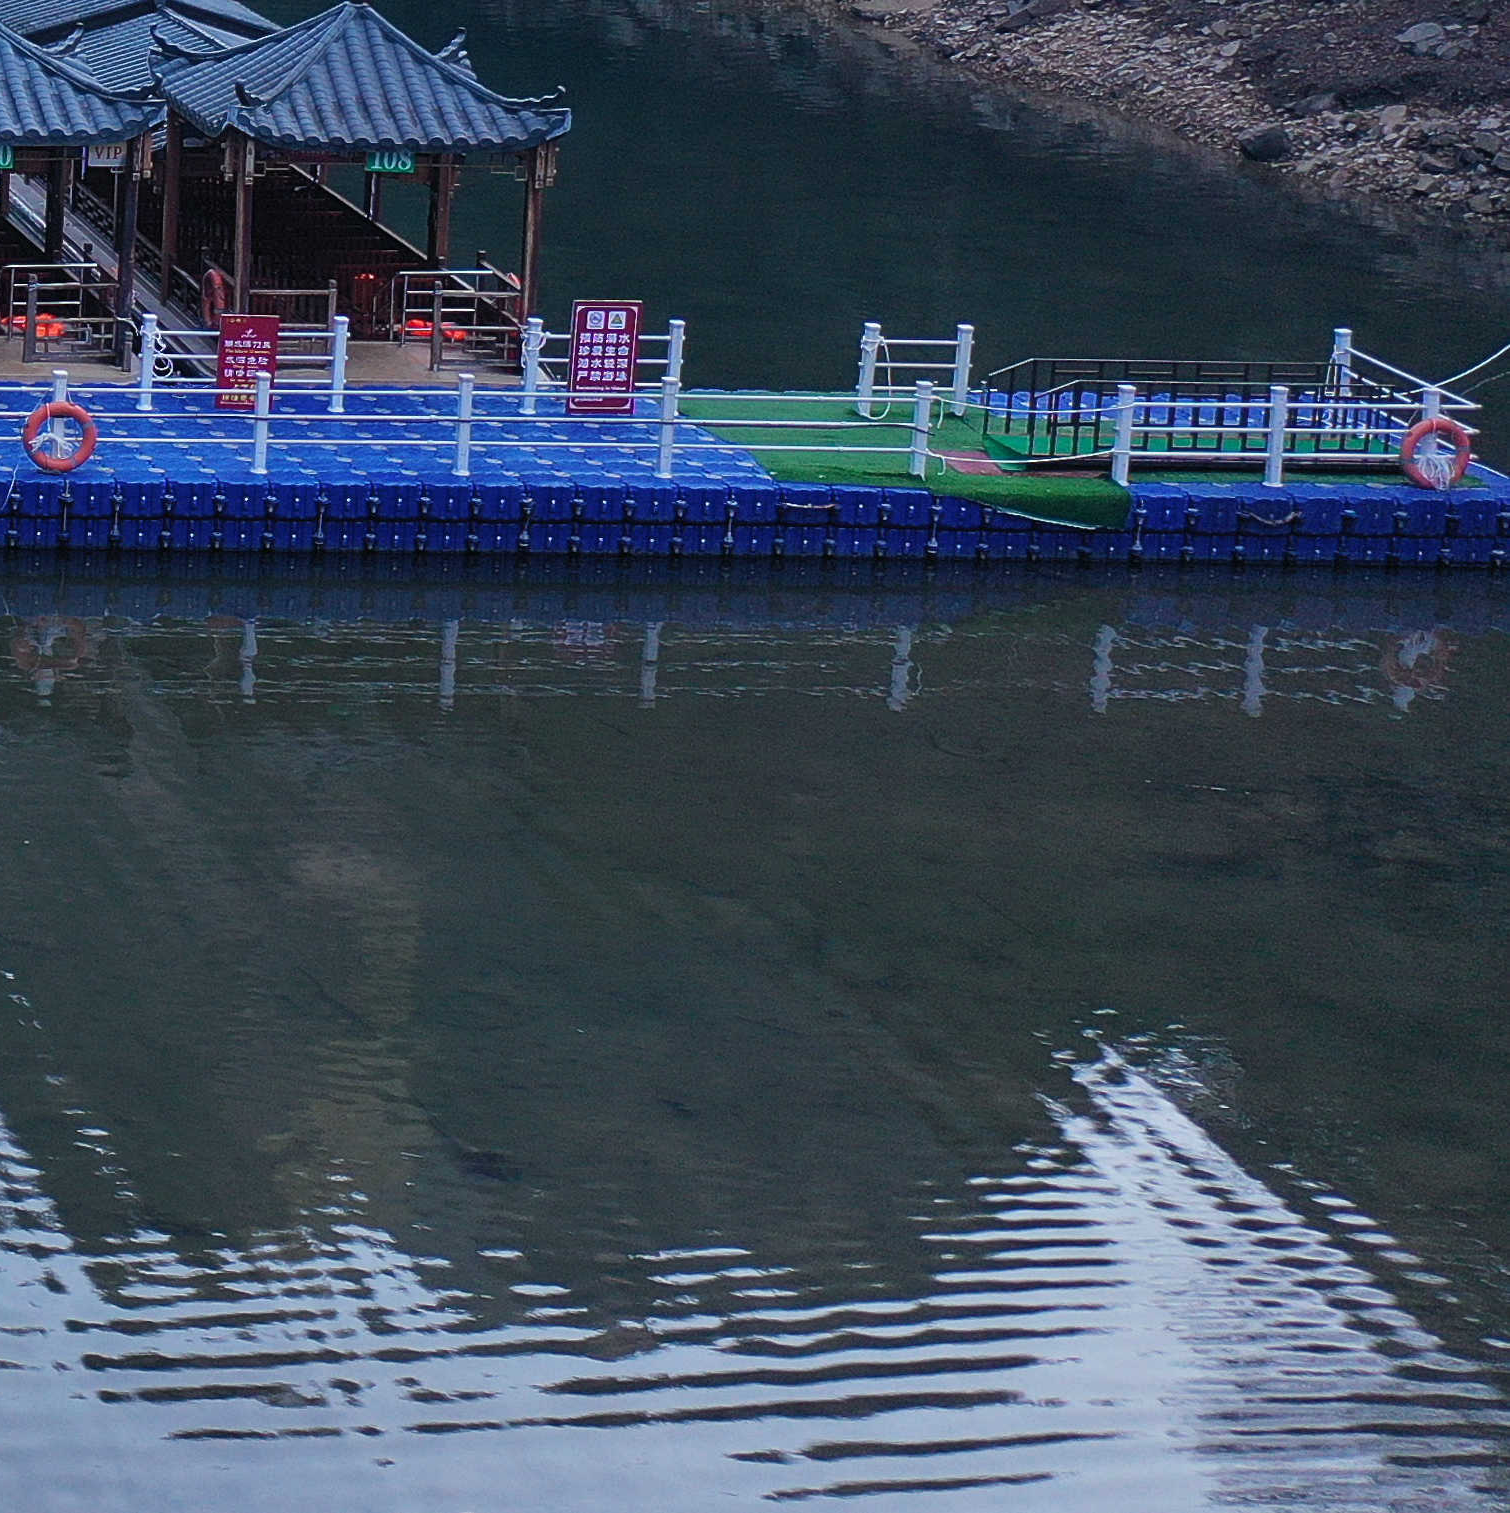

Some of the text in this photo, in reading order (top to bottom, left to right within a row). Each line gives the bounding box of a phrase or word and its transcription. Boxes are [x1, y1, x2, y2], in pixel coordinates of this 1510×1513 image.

[94, 146, 123, 160] VIP
[370, 149, 412, 171] 108
[576, 370, 628, 382] 严禁游泳
